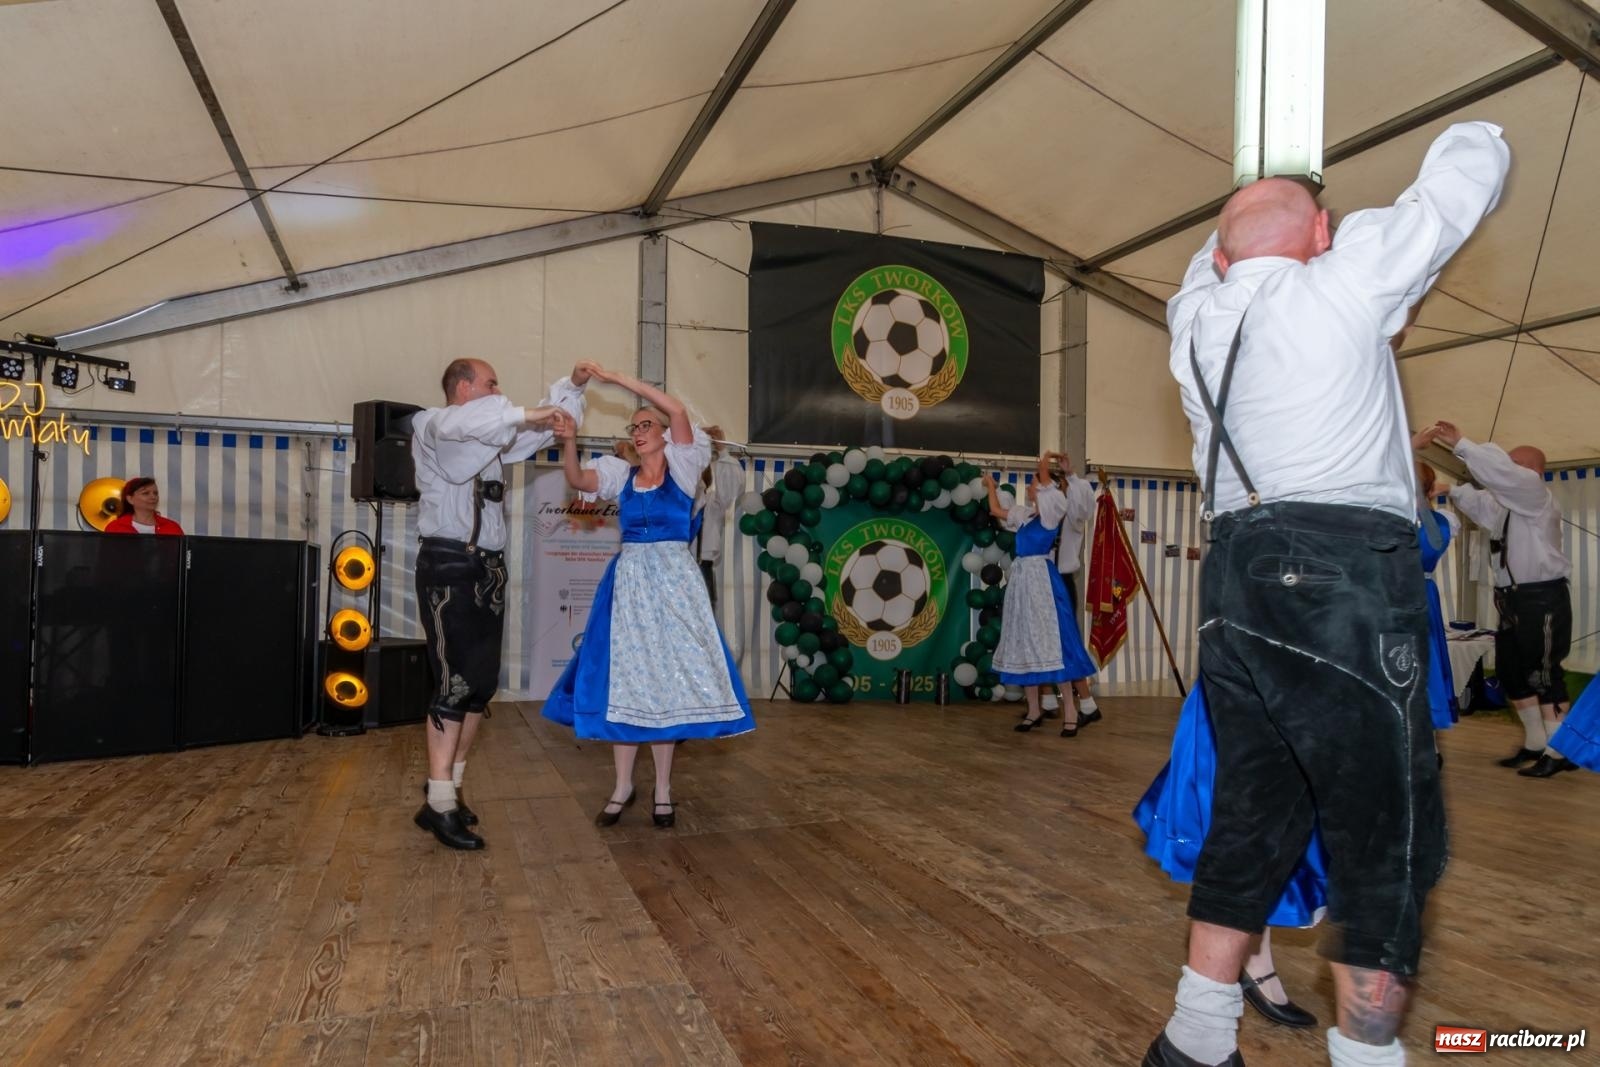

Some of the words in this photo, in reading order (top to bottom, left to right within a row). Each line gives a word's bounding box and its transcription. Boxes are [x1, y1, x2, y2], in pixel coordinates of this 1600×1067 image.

[838, 287, 866, 326] LKS
[0, 382, 45, 416] DJ
[888, 396, 914, 411] 1905
[538, 502, 599, 515] Tworkauer
[828, 539, 854, 577] LKS
[872, 640, 897, 652] 1905
